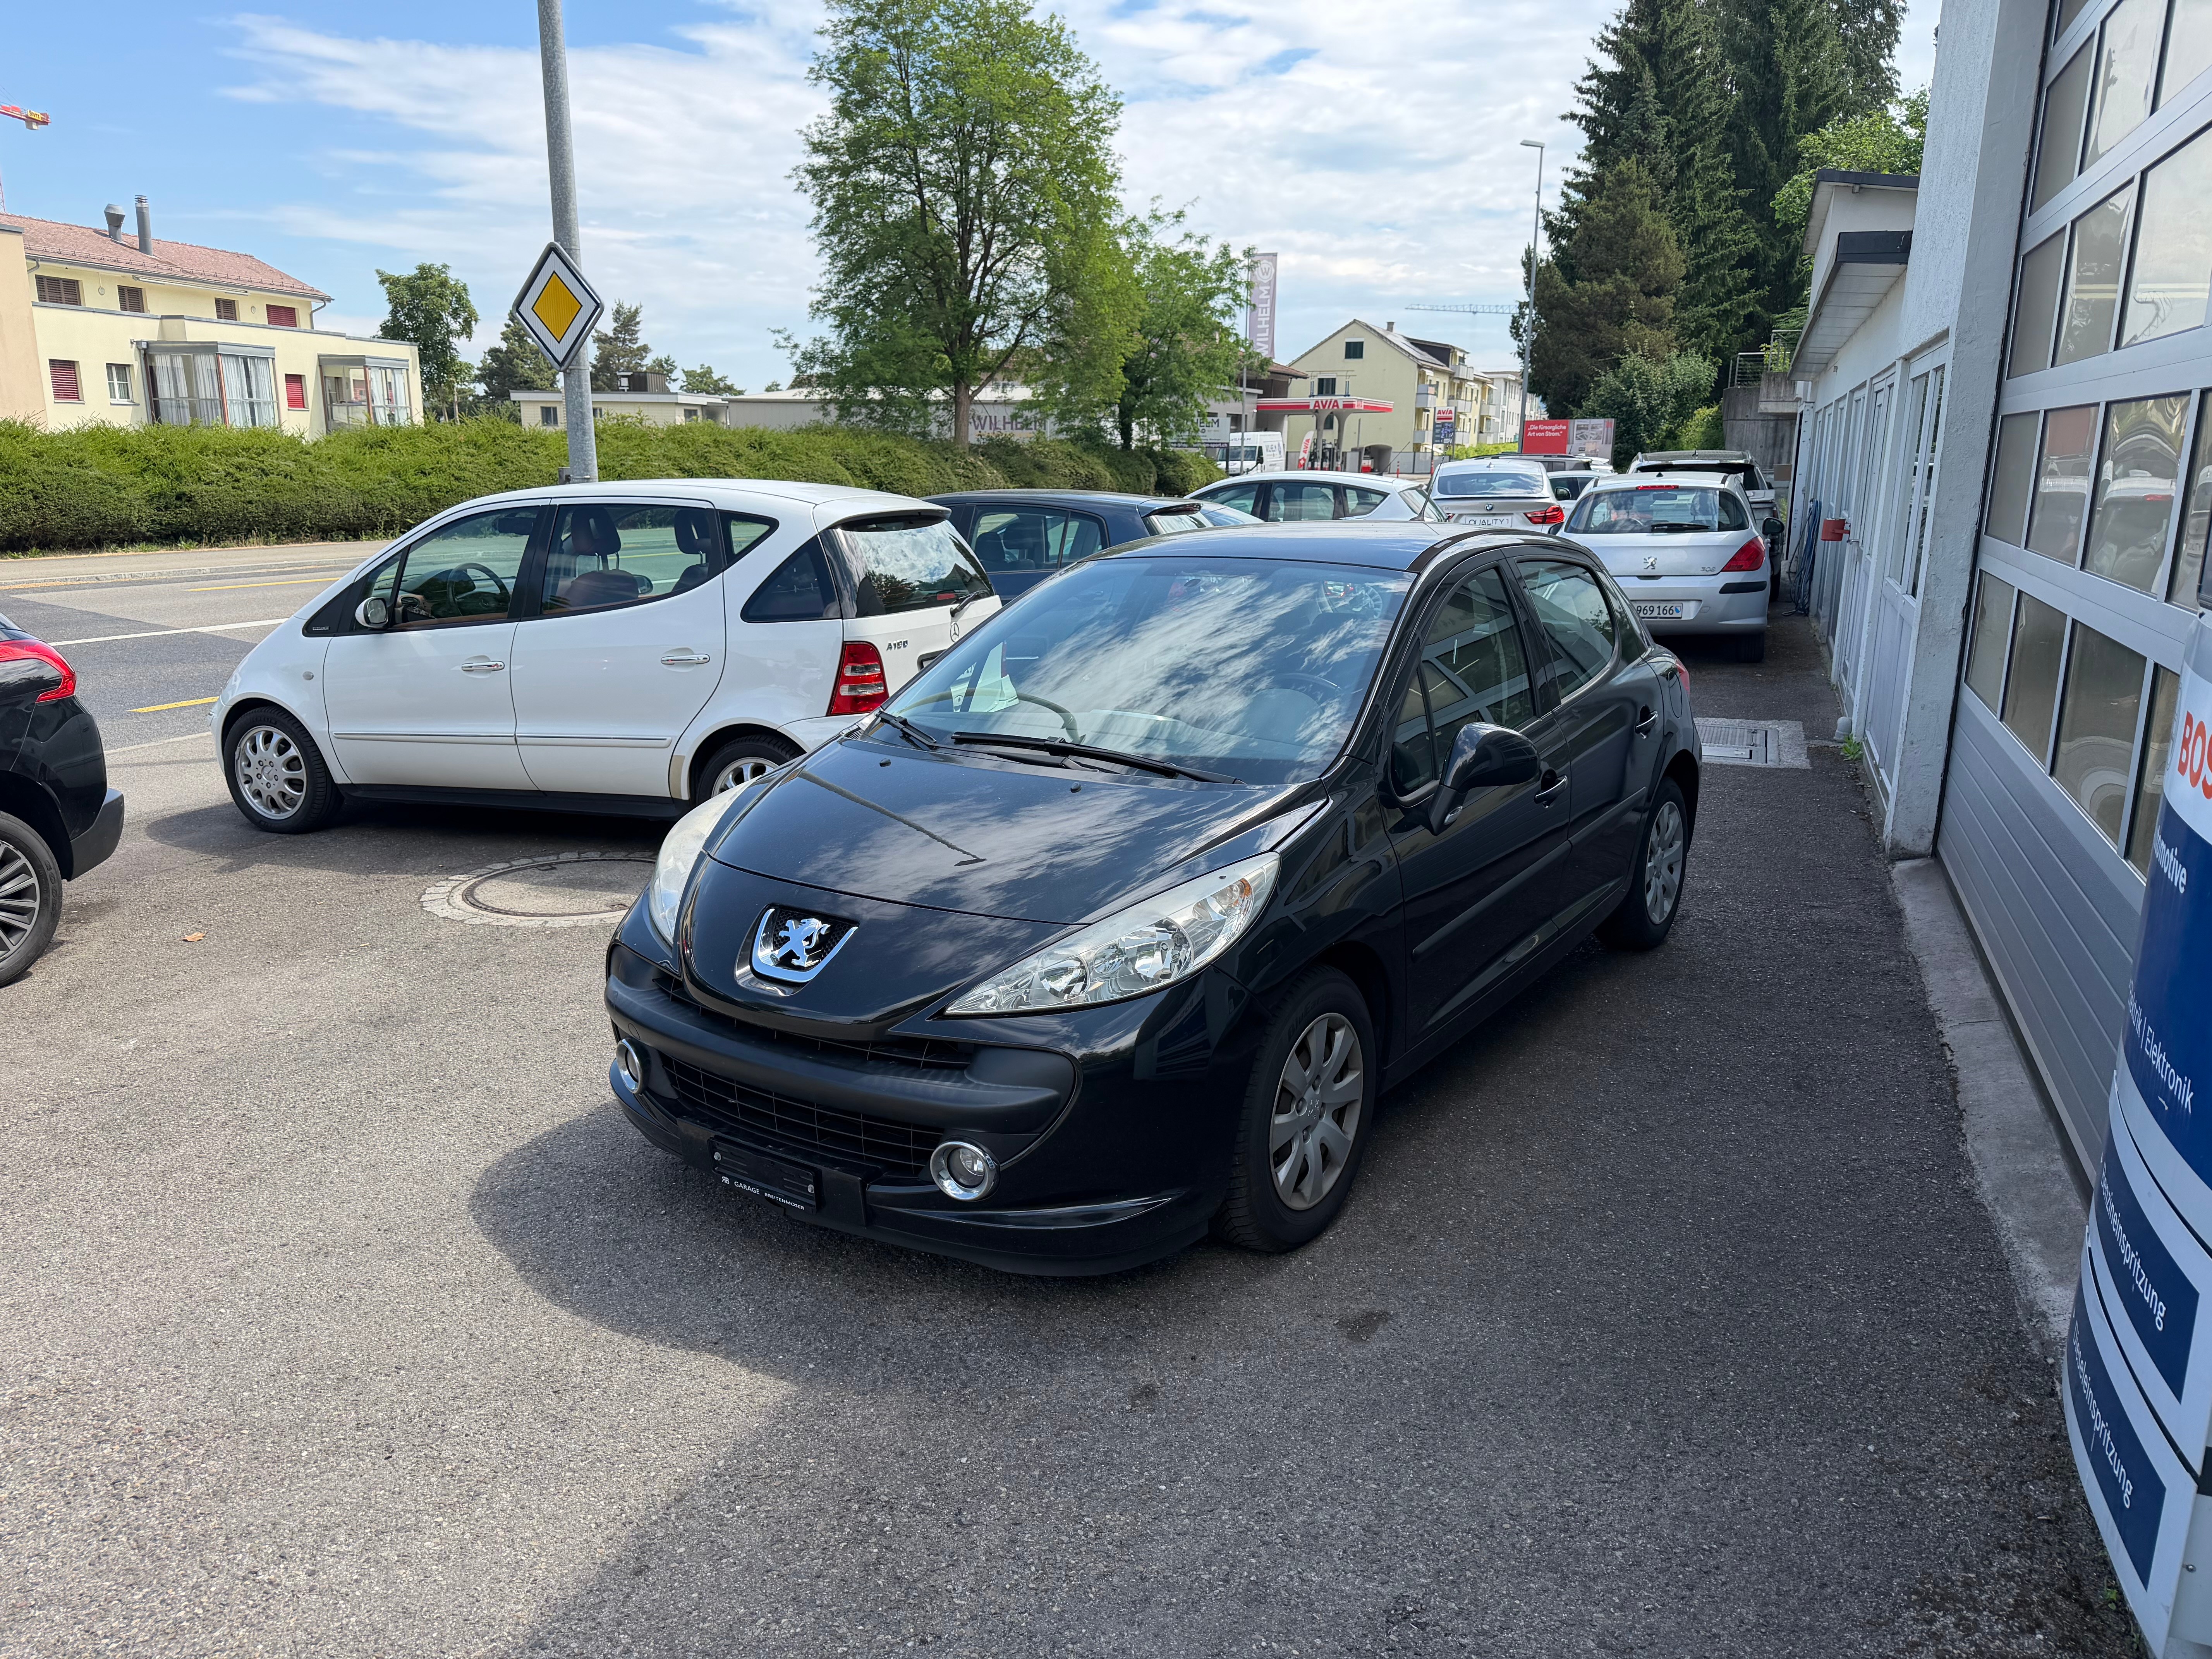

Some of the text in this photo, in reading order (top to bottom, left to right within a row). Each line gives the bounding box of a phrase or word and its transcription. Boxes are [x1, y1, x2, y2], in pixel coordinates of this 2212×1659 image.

[1256, 286, 1271, 356] WILHELM
[1313, 398, 1340, 409] AVIA
[1302, 438, 1310, 454] AVIA
[1637, 605, 1674, 615] 969 166
[2145, 1025, 2194, 1114] Elektronik
[734, 1181, 760, 1195] GARAGE
[764, 1192, 805, 1211] BREITENMOSER
[2101, 1161, 2166, 1331] Benzineinspritzung
[2073, 1320, 2133, 1509] Dieseleinspritzung
